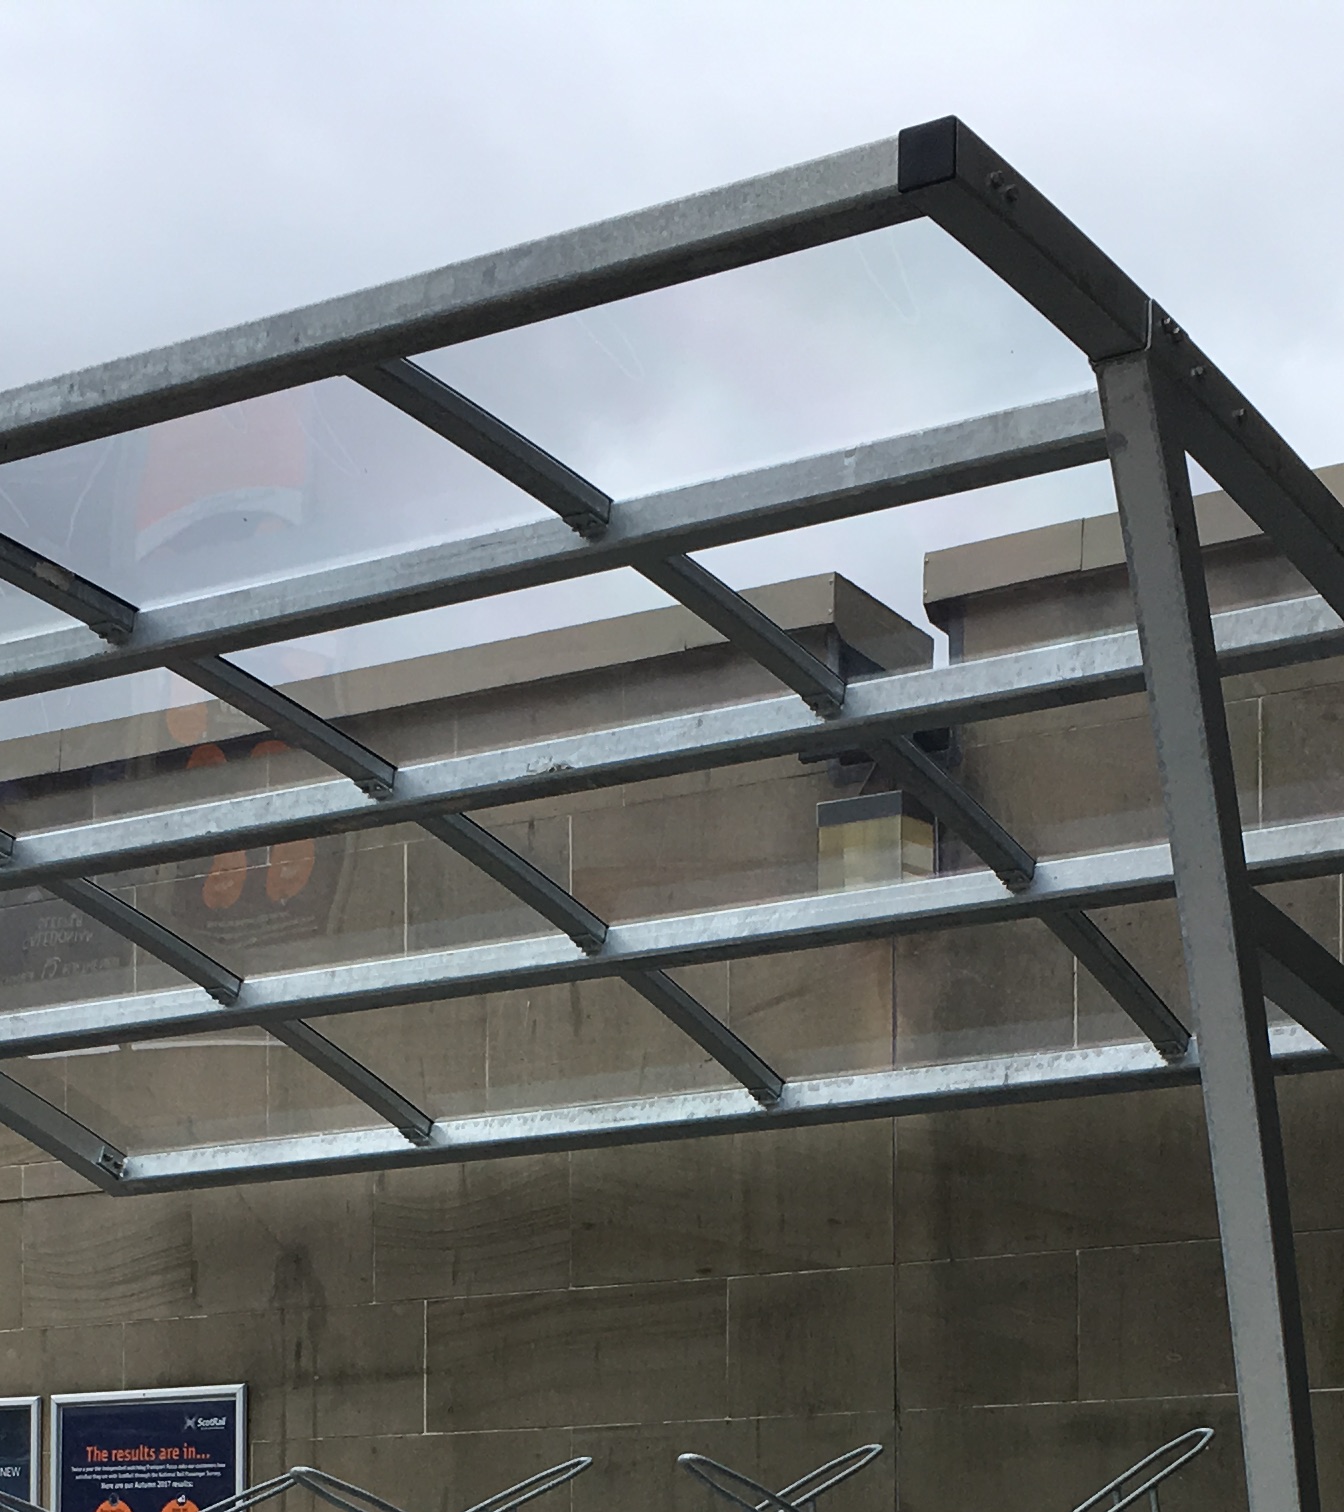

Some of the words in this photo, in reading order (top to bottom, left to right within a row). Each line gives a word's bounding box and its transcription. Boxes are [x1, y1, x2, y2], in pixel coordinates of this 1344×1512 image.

[197, 1417, 227, 1427] ScotRail
[86, 1446, 109, 1462] The
[111, 1444, 156, 1461] results
[158, 1447, 180, 1460] are
[183, 1442, 211, 1459] in...
[0, 1467, 21, 1477] NEW
